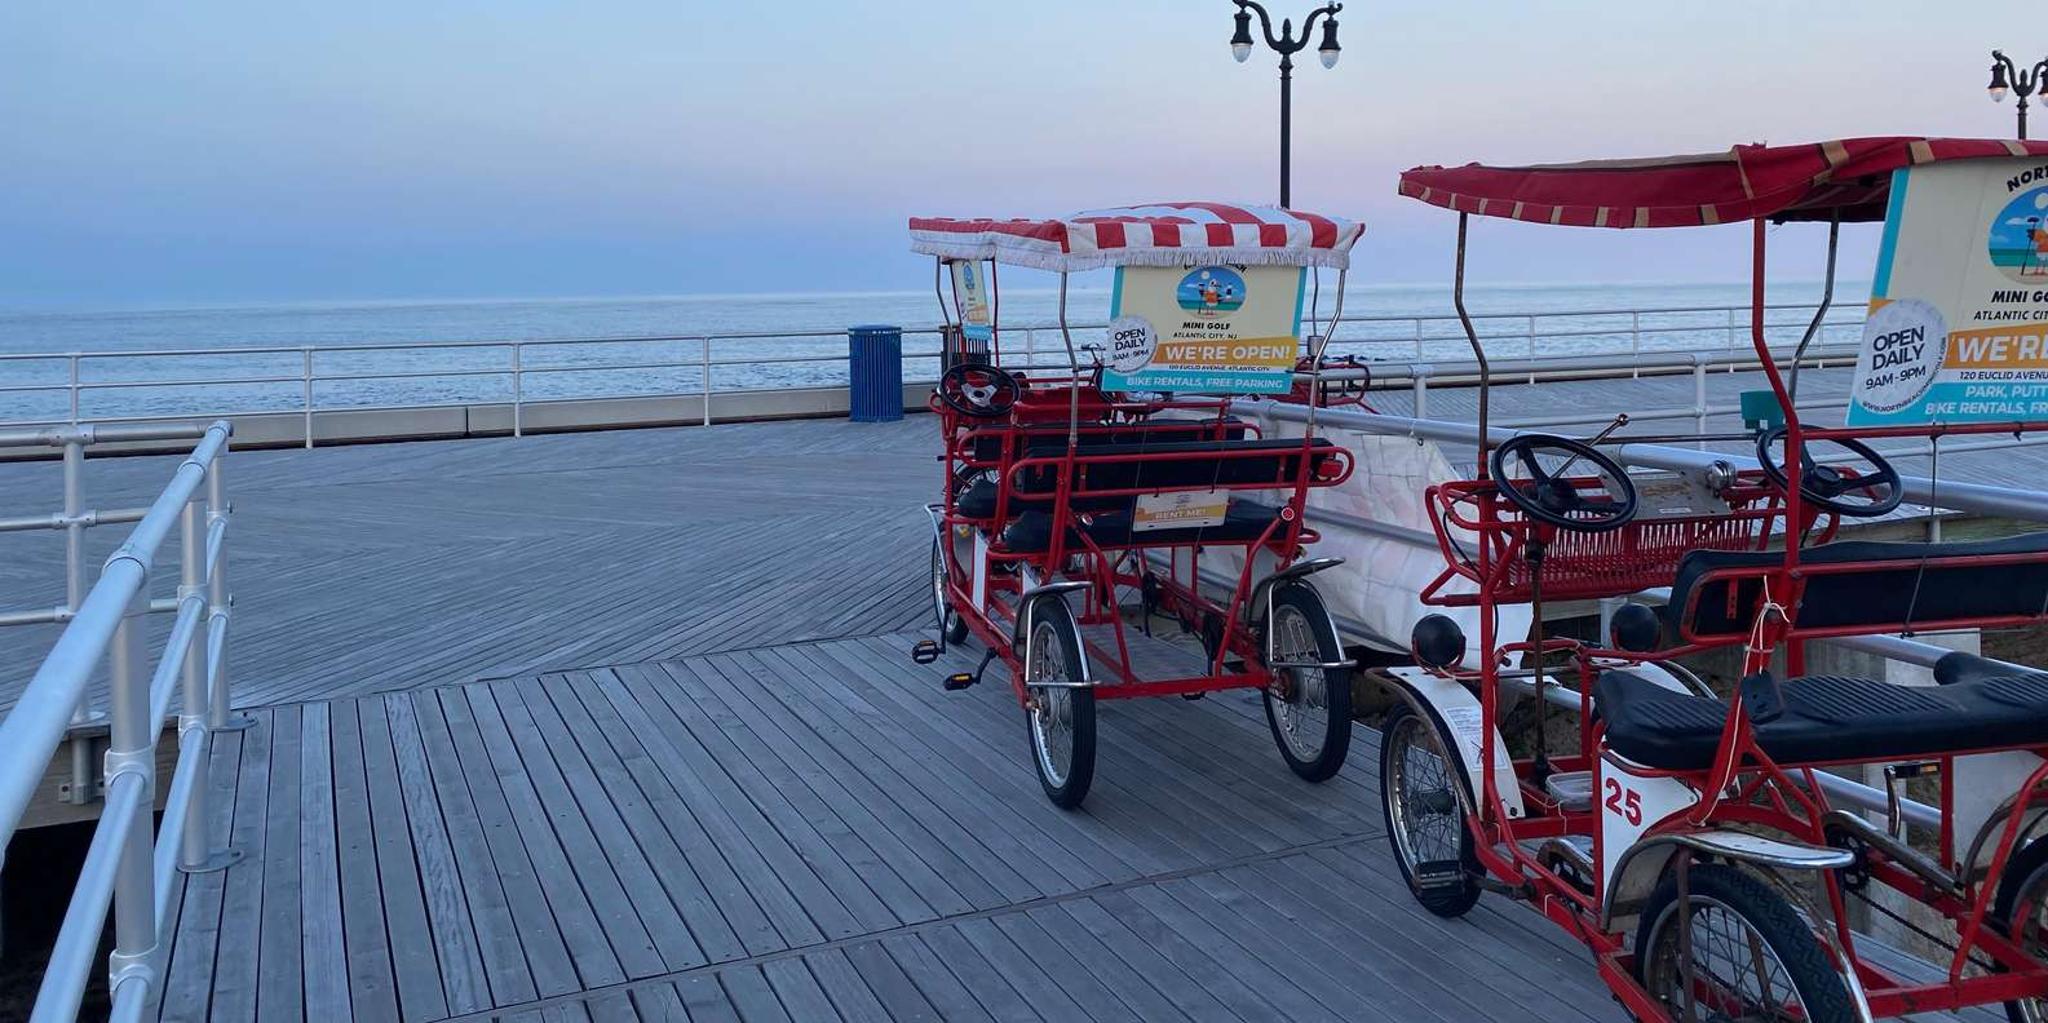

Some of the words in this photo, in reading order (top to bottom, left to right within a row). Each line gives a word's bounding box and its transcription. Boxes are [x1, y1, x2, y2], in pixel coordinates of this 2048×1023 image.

[1991, 290, 2028, 303] MINI
[1973, 310, 2030, 320] ATLANTIC
[1182, 322, 1204, 330] MINI
[1207, 322, 1231, 330] GOLF
[1114, 327, 1146, 341] OPEN
[1873, 325, 1924, 352] OPEN
[1114, 337, 1146, 351] DAILY
[1166, 345, 1228, 360] WE'RE
[1232, 345, 1291, 360] OPEN!
[1872, 343, 1925, 371] DAILY
[1126, 376, 1152, 386] BIKE
[1206, 378, 1233, 387] FREE
[1235, 379, 1283, 389] PARKING
[1960, 371, 1977, 380] 120
[1978, 371, 2013, 380] EUCLID
[1965, 384, 2007, 399] PARK,
[2012, 384, 2048, 398] PUTT
[1959, 401, 2027, 416] RENTALS,
[1155, 510, 1184, 519] RENT
[1605, 777, 1642, 827] 25
